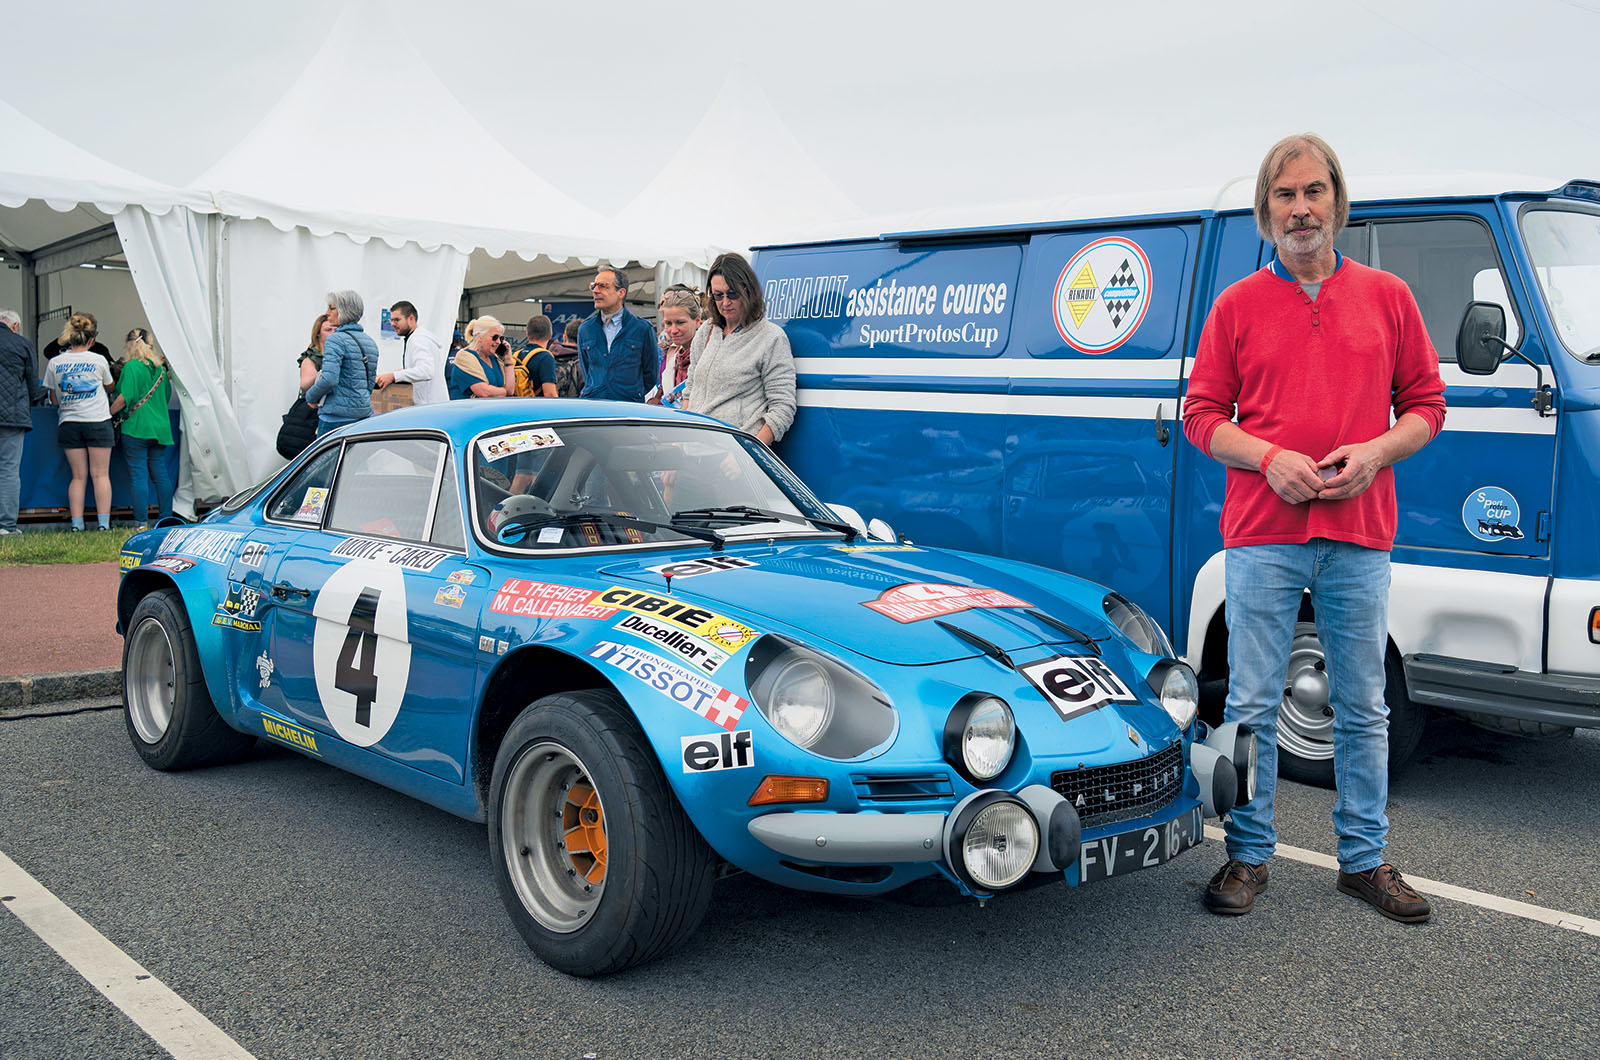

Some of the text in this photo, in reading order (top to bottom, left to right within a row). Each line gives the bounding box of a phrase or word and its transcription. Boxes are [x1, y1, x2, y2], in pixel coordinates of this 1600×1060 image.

[764, 274, 1008, 319] RENAULT assistance course
[1068, 288, 1096, 301] RENAULT
[859, 321, 999, 349] SportProtosCup
[1486, 508, 1512, 519] CUP
[242, 544, 267, 566] elf
[661, 556, 751, 575] elf
[493, 595, 618, 618] M. CALLEWAERT
[525, 582, 593, 602] THERIER
[600, 589, 715, 629] CIBIE
[620, 615, 708, 660] Ducellier
[335, 586, 382, 728] 4
[624, 645, 718, 695] CHRONOGRAPHES
[613, 651, 714, 713] TISSOT
[1042, 659, 1127, 703] elf
[263, 718, 318, 752] MICHELIN
[683, 731, 752, 771] elf
